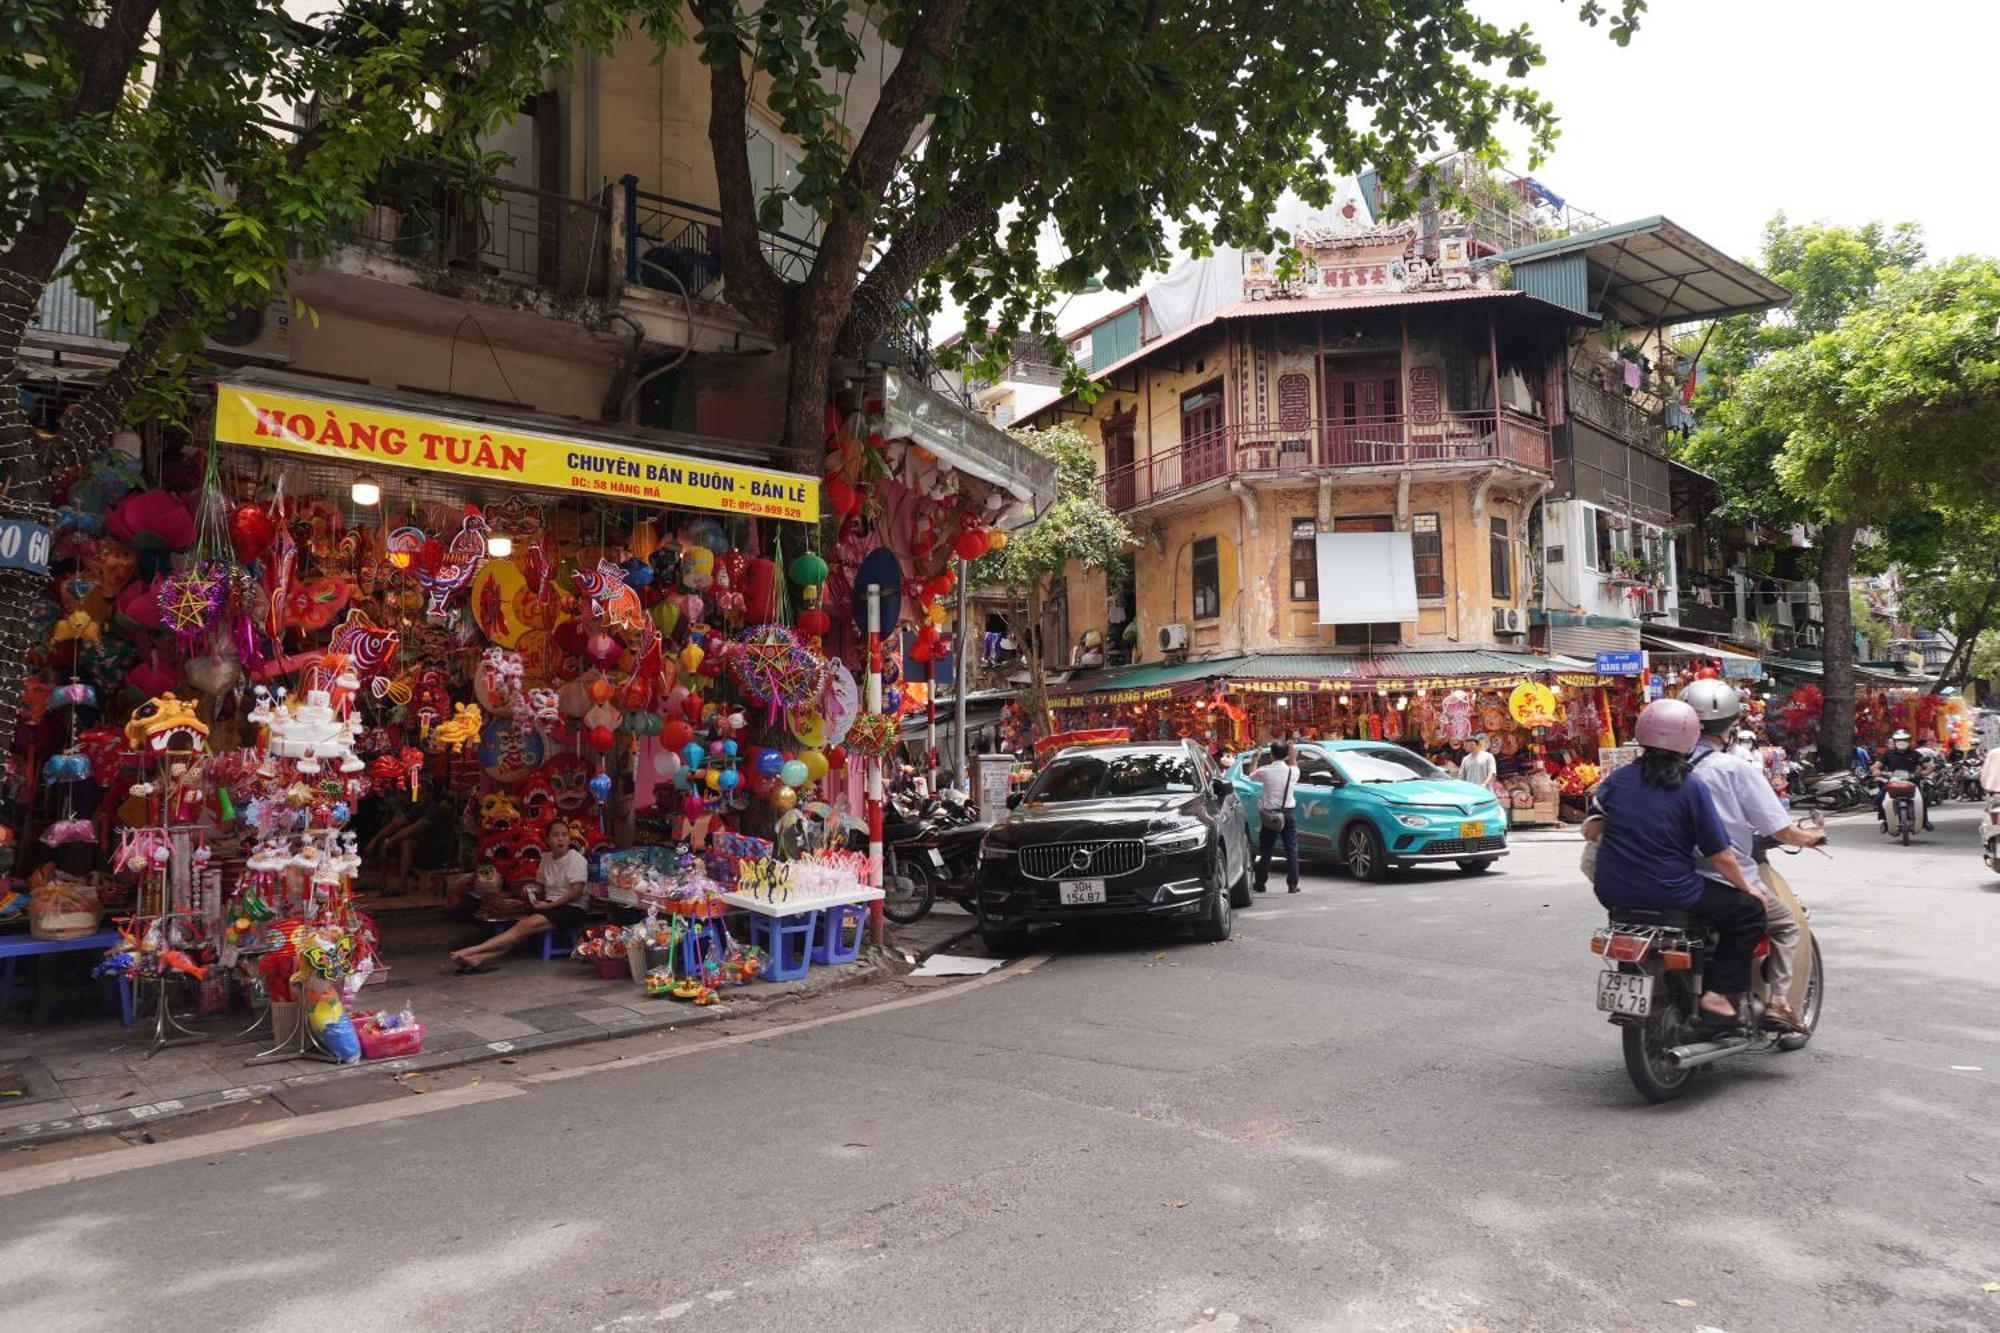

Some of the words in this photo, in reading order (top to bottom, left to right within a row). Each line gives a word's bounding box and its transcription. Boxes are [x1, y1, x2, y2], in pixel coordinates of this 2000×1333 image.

[254, 408, 408, 455] HOÀNG
[567, 452, 640, 478] CHUYÊN
[646, 463, 682, 484] BÁN
[688, 471, 734, 492] BUÔN
[751, 479, 783, 499] BÁN
[29, 531, 49, 567] 60
[1072, 881, 1092, 892] 30H
[1606, 974, 1644, 995] 29-C1
